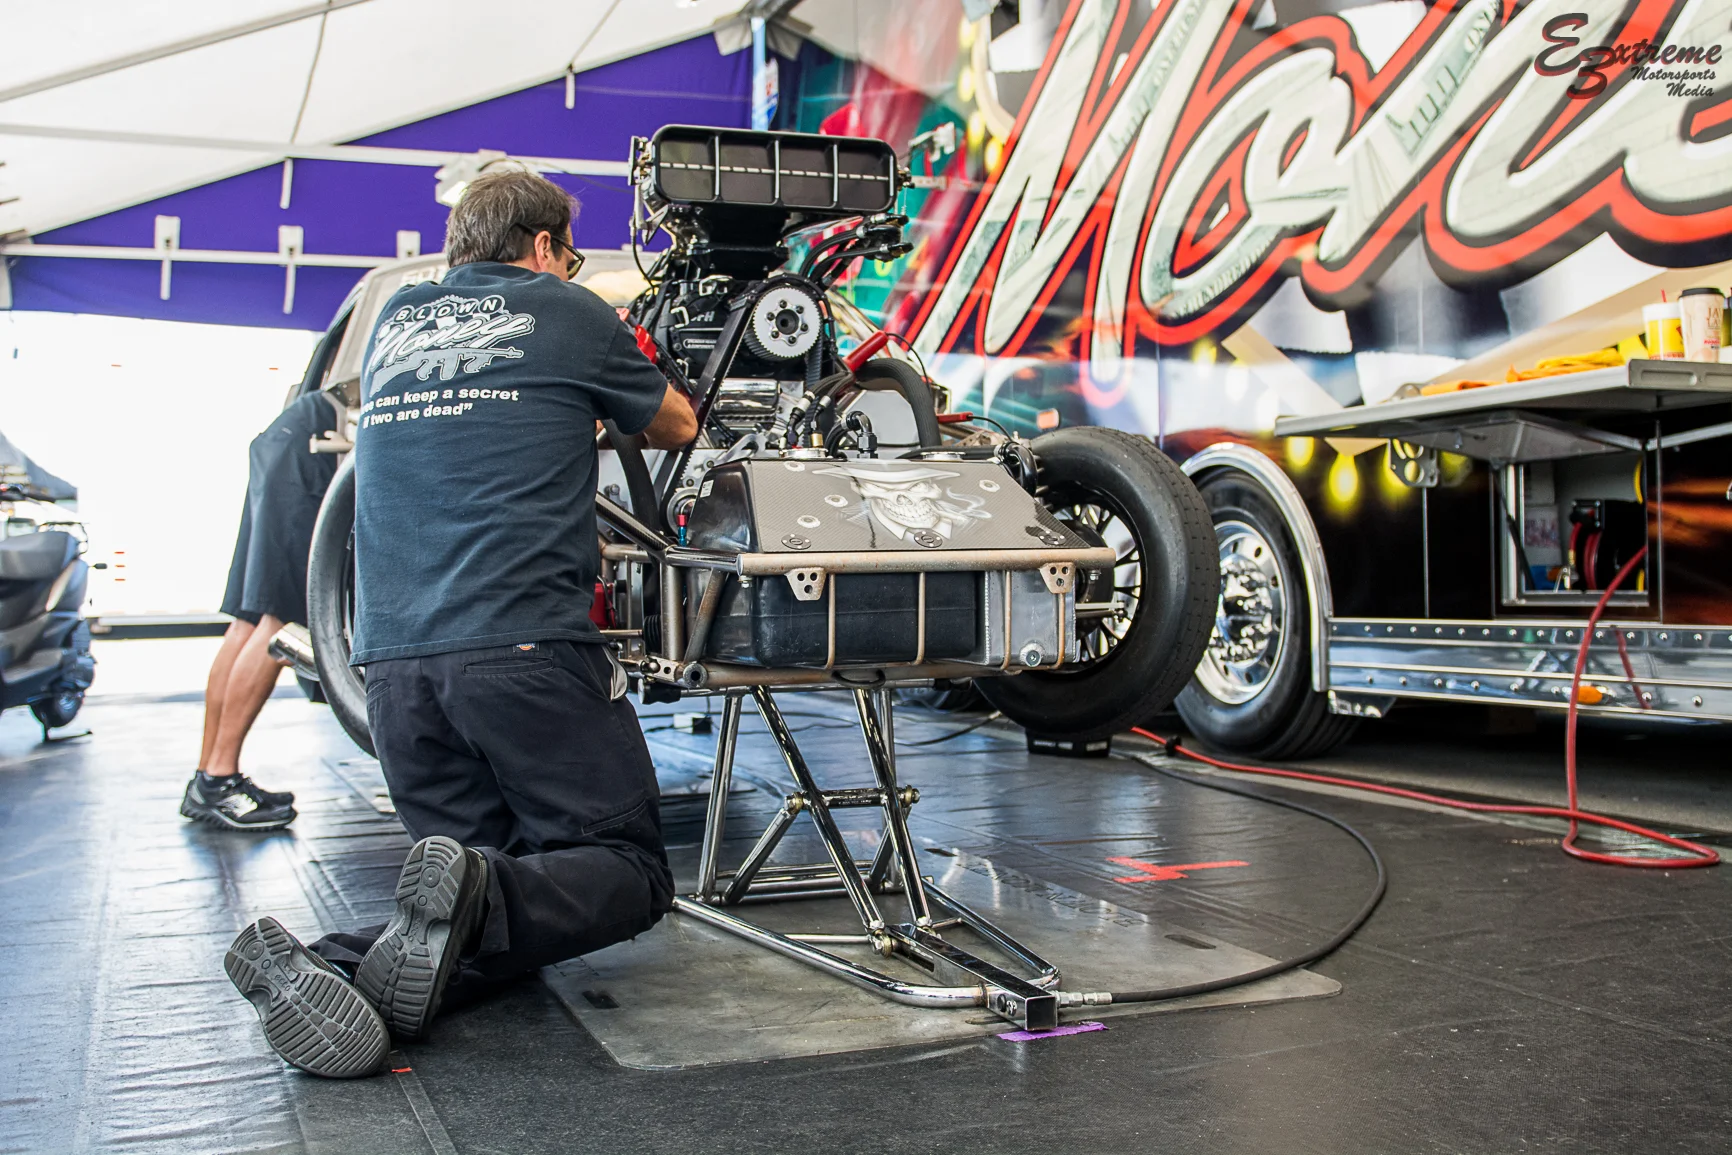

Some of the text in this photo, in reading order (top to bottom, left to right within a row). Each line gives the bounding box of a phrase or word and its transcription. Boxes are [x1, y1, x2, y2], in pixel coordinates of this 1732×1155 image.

[397, 297, 501, 322] BLOWN
[375, 396, 400, 408] can
[403, 390, 438, 403] keep
[442, 389, 454, 399] a
[458, 388, 519, 401] secret
[371, 412, 393, 426] two
[396, 409, 420, 421] are
